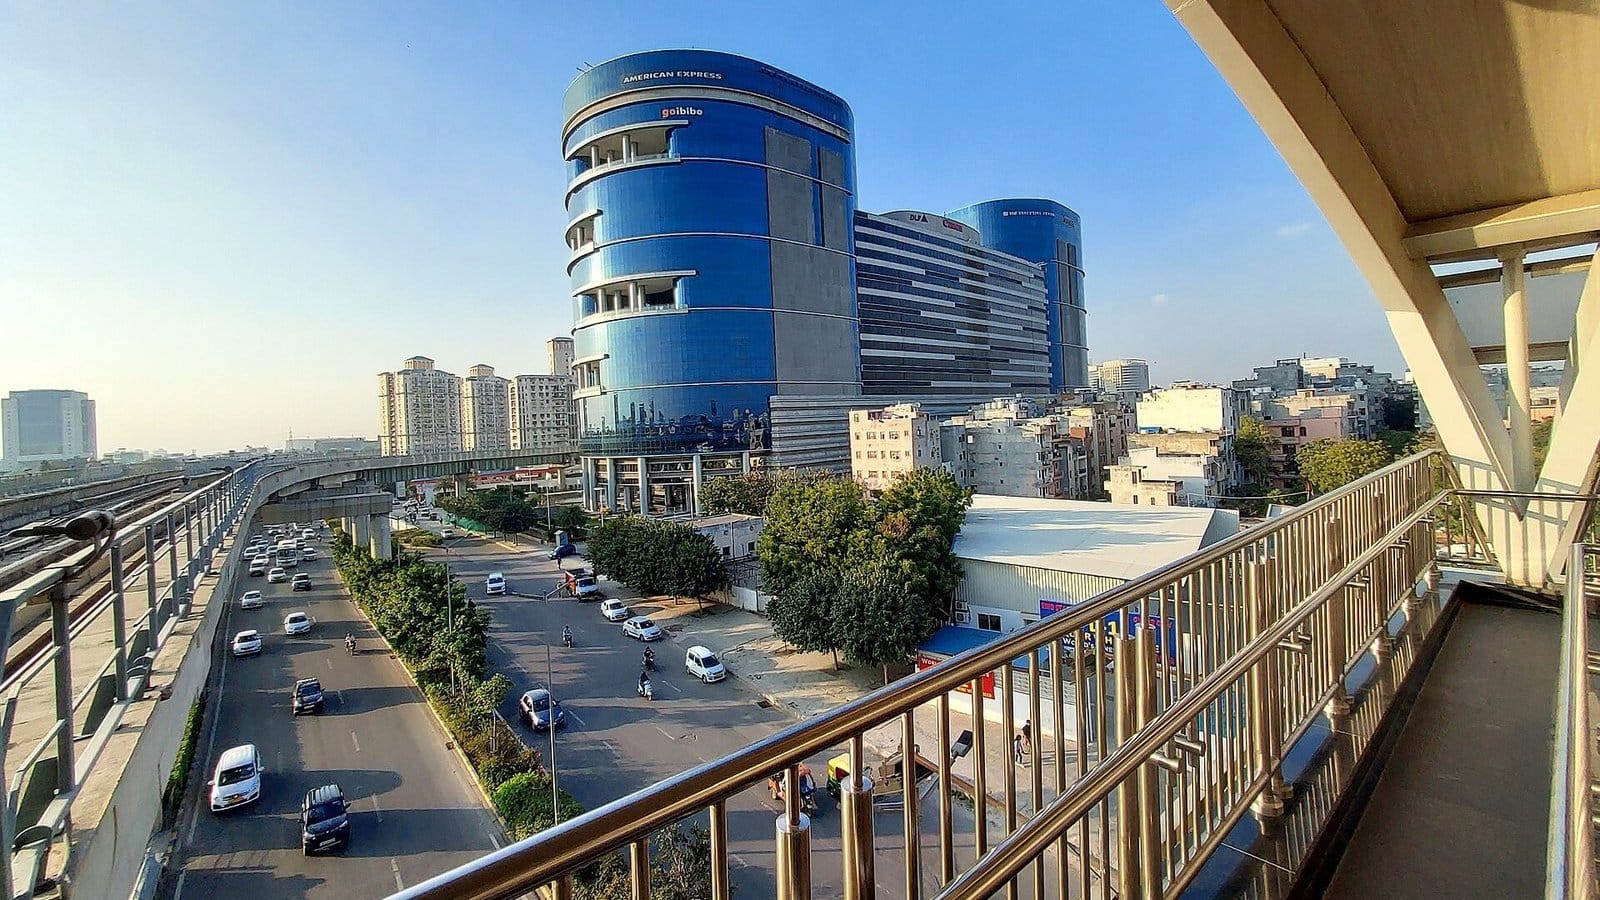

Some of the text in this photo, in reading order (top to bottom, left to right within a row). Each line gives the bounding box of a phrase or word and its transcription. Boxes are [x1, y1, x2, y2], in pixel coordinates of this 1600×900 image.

[623, 71, 722, 83] AMERICAN EXPRESS
[662, 107, 703, 118] goibibo
